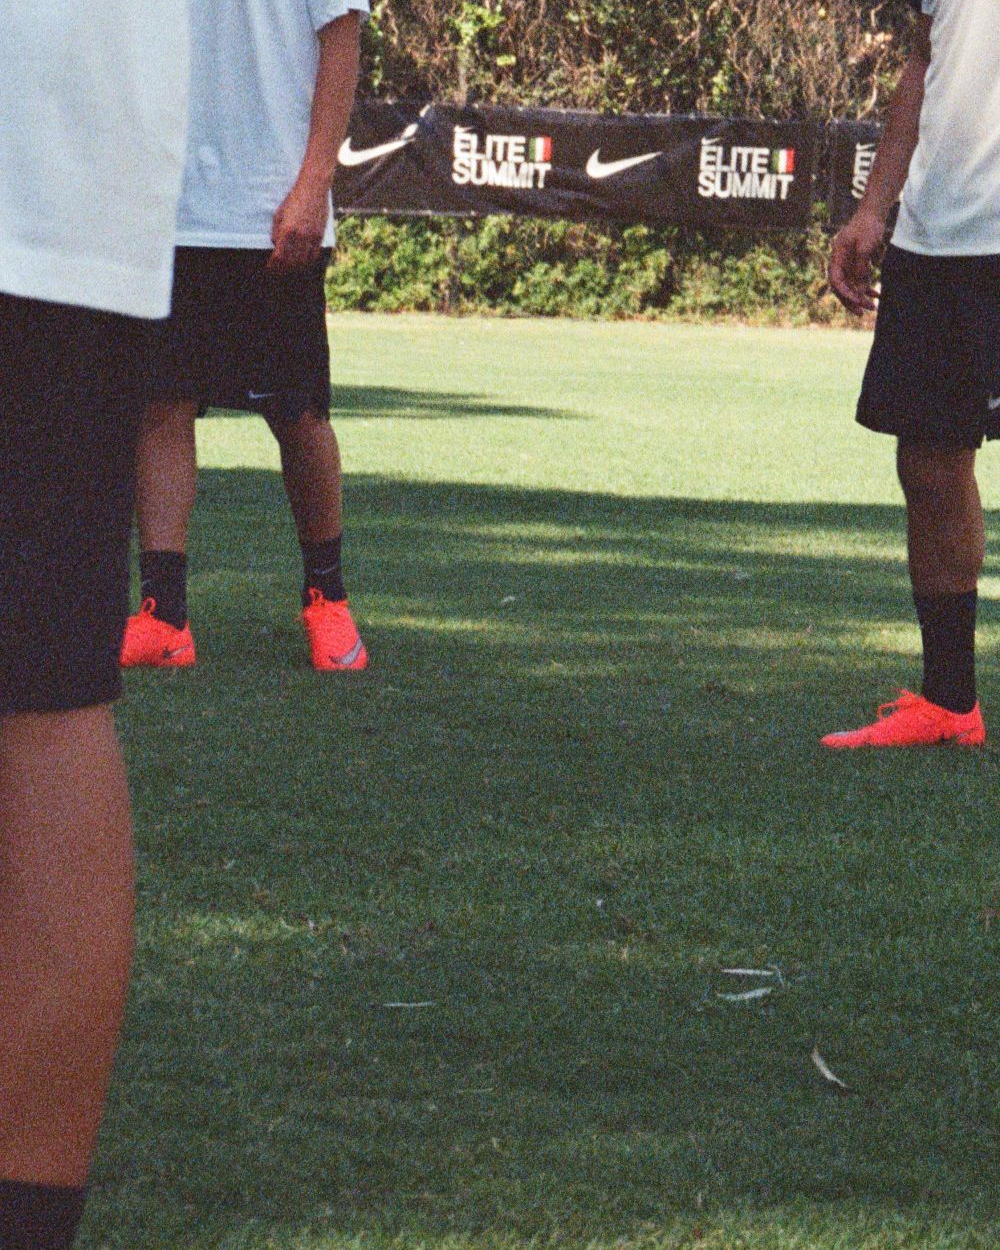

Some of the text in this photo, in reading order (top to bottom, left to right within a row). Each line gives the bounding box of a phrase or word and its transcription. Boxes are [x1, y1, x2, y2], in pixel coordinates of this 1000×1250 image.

[453, 132, 527, 162] ELITE
[700, 146, 770, 172] ELITE
[451, 158, 553, 189] SUMMIT
[697, 170, 795, 200] SUMMIT
